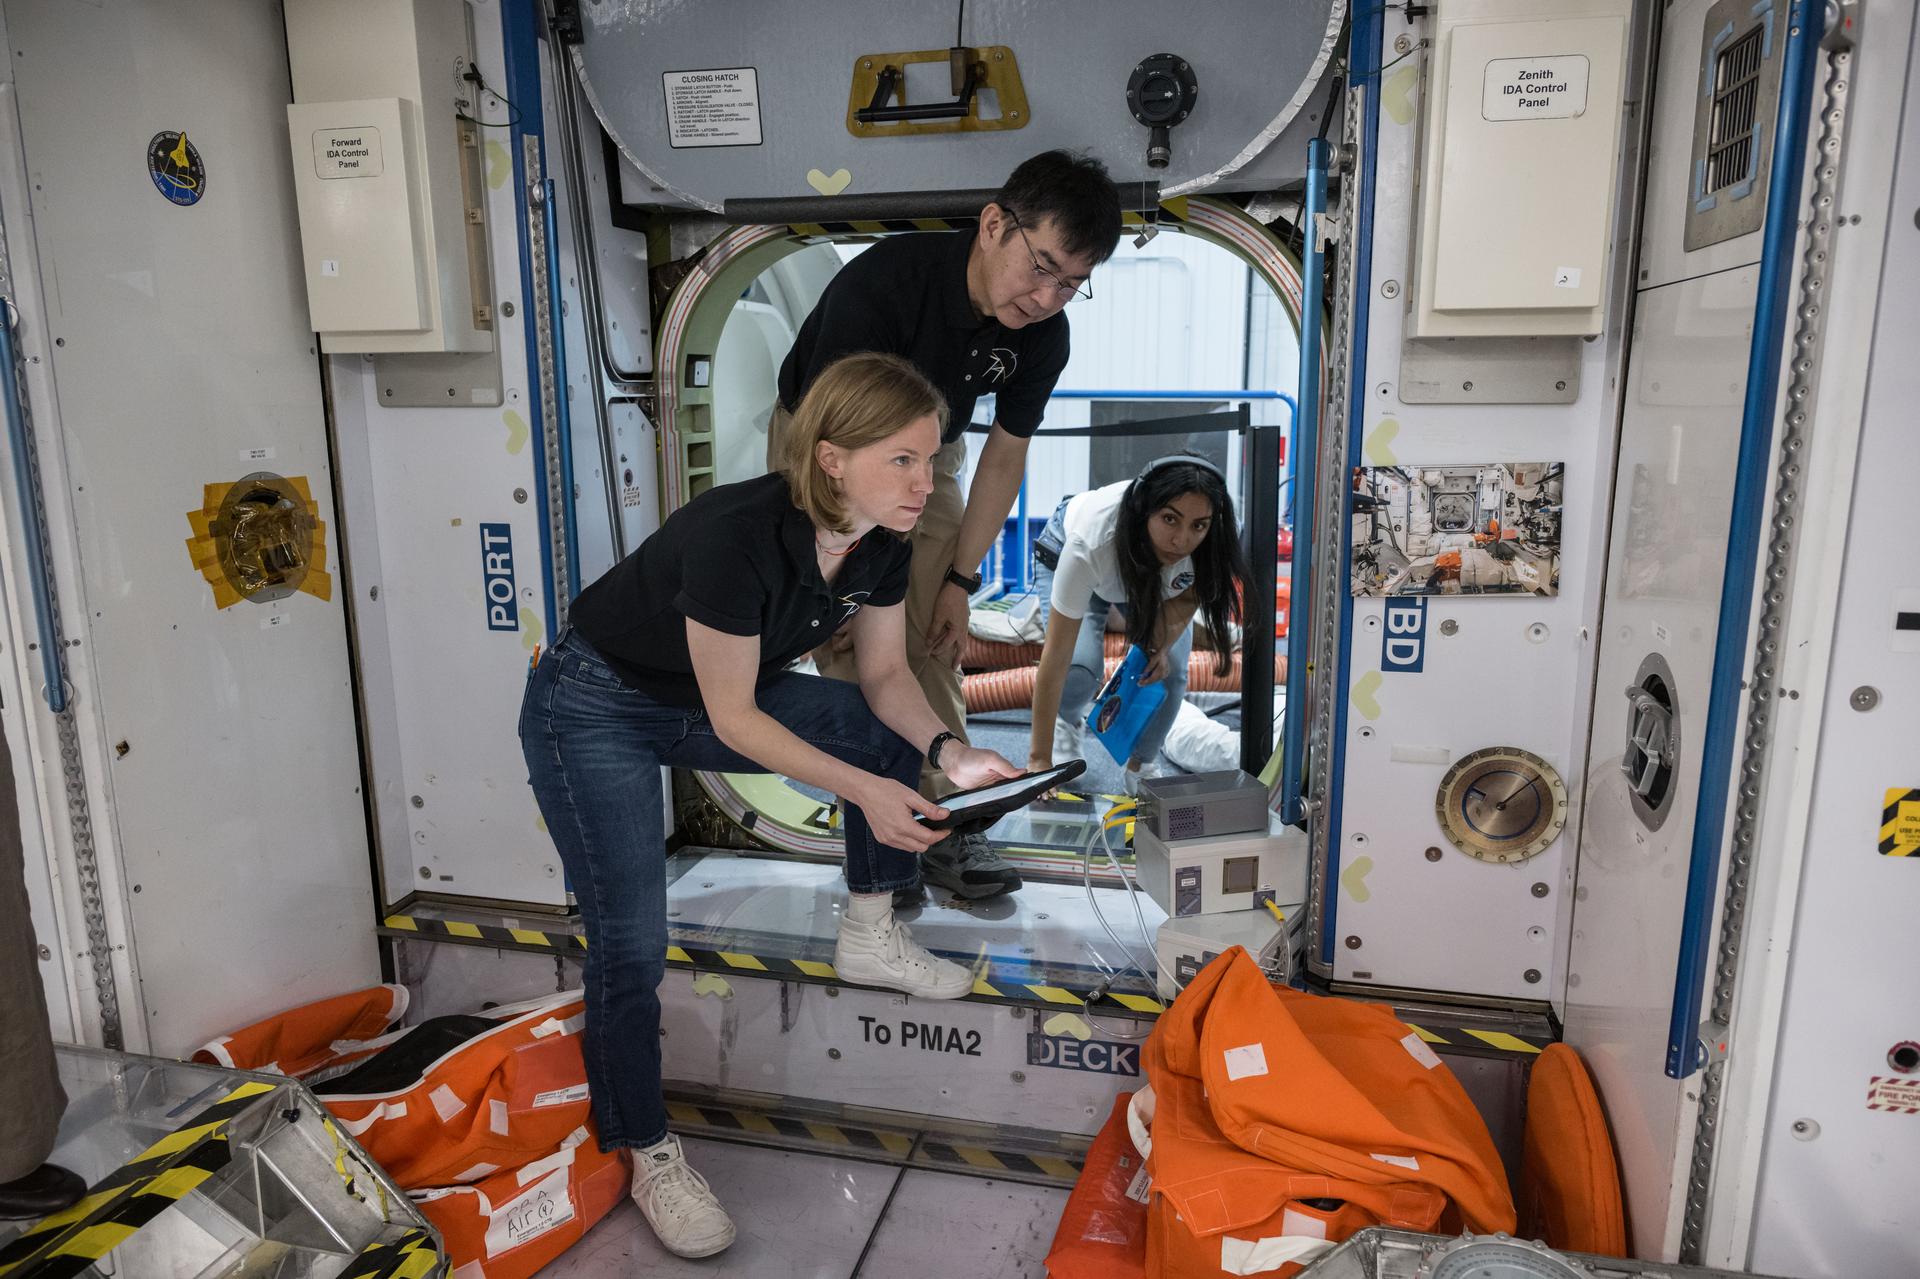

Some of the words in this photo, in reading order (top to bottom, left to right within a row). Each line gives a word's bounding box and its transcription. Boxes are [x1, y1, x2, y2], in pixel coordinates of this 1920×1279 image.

[682, 74, 713, 83] CLOSING
[1518, 70, 1553, 80] Zenith
[1503, 85, 1523, 94] IDA
[1526, 83, 1567, 94] Control
[1518, 97, 1549, 108] Panel
[332, 138, 361, 147] Forward
[342, 149, 368, 157] Control
[484, 528, 516, 626] PORT
[858, 1016, 890, 1045] To
[902, 1020, 981, 1056] PMA2
[1038, 1038, 1136, 1073] DECK
